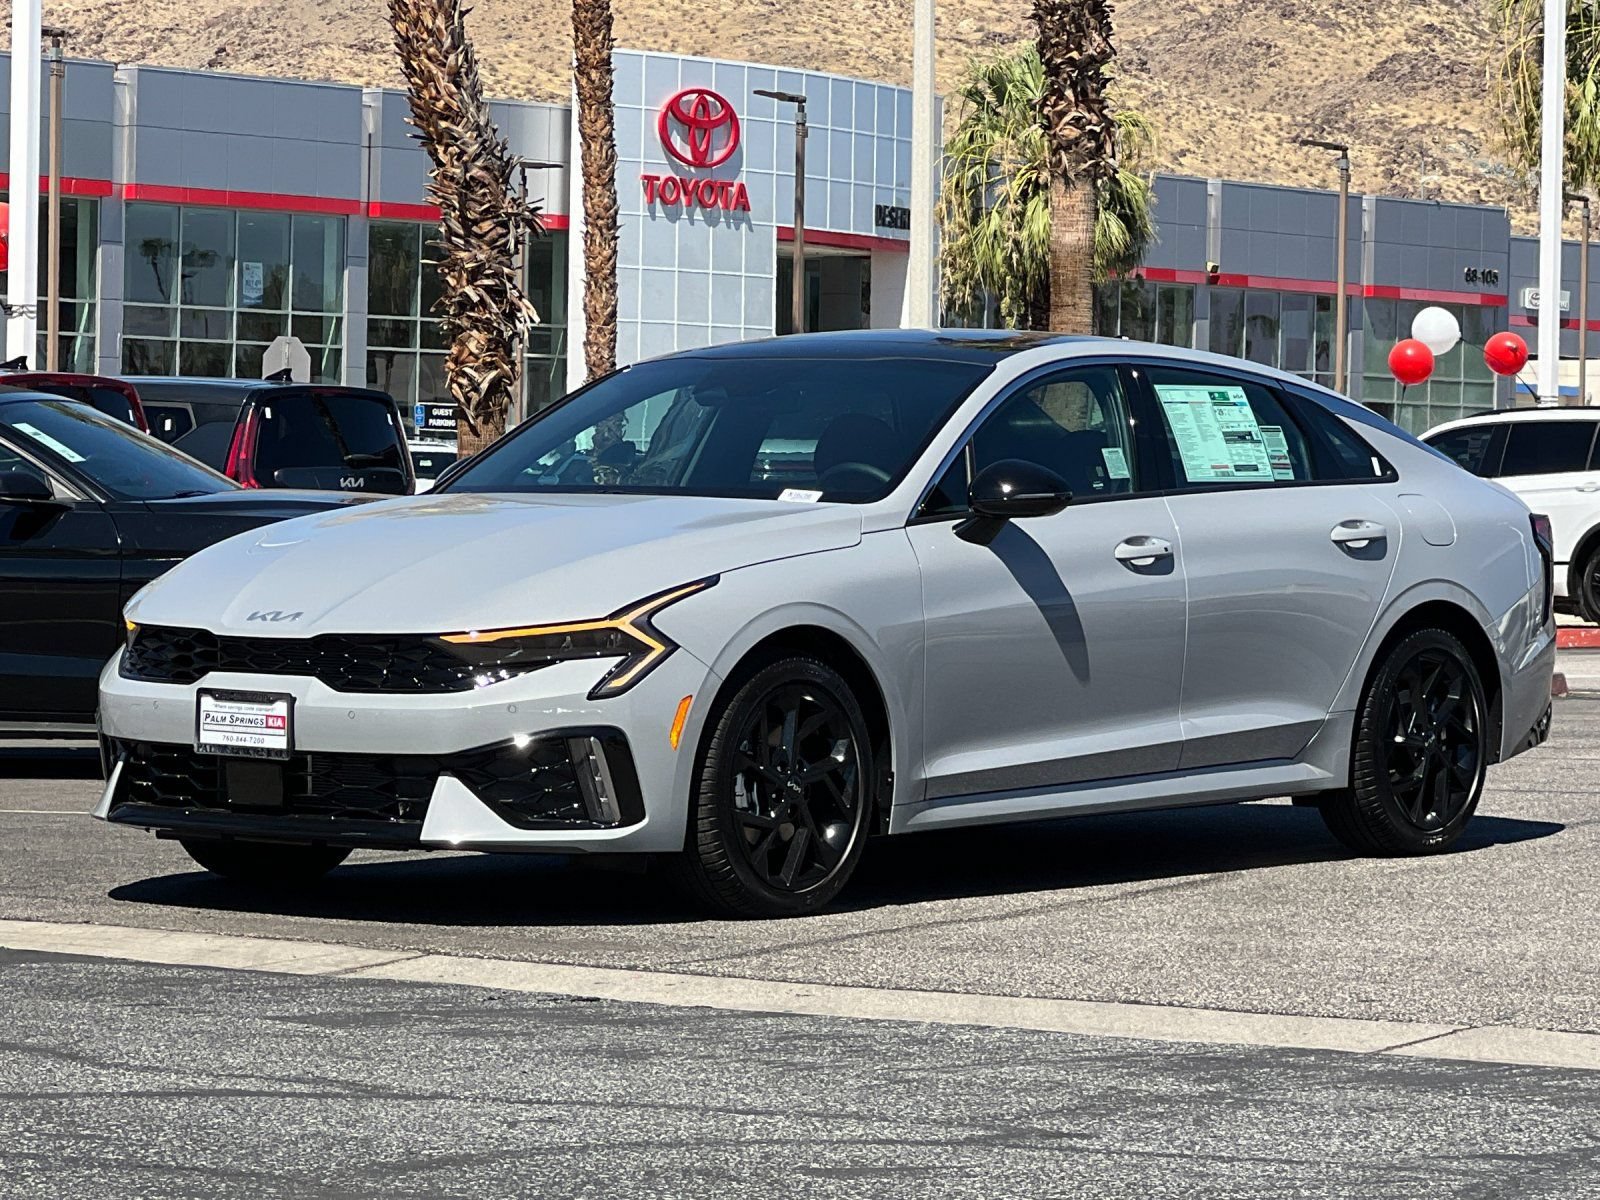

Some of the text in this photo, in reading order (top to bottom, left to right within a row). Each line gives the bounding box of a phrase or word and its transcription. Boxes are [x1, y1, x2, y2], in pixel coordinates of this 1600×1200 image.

[640, 174, 751, 212] TOYOTA
[1464, 267, 1499, 284] 68-105
[432, 408, 454, 417] GUEST
[428, 418, 456, 427] PARKING
[204, 713, 284, 727] PALM SPRINGS KIA
[222, 735, 265, 744] 760-844-7200
